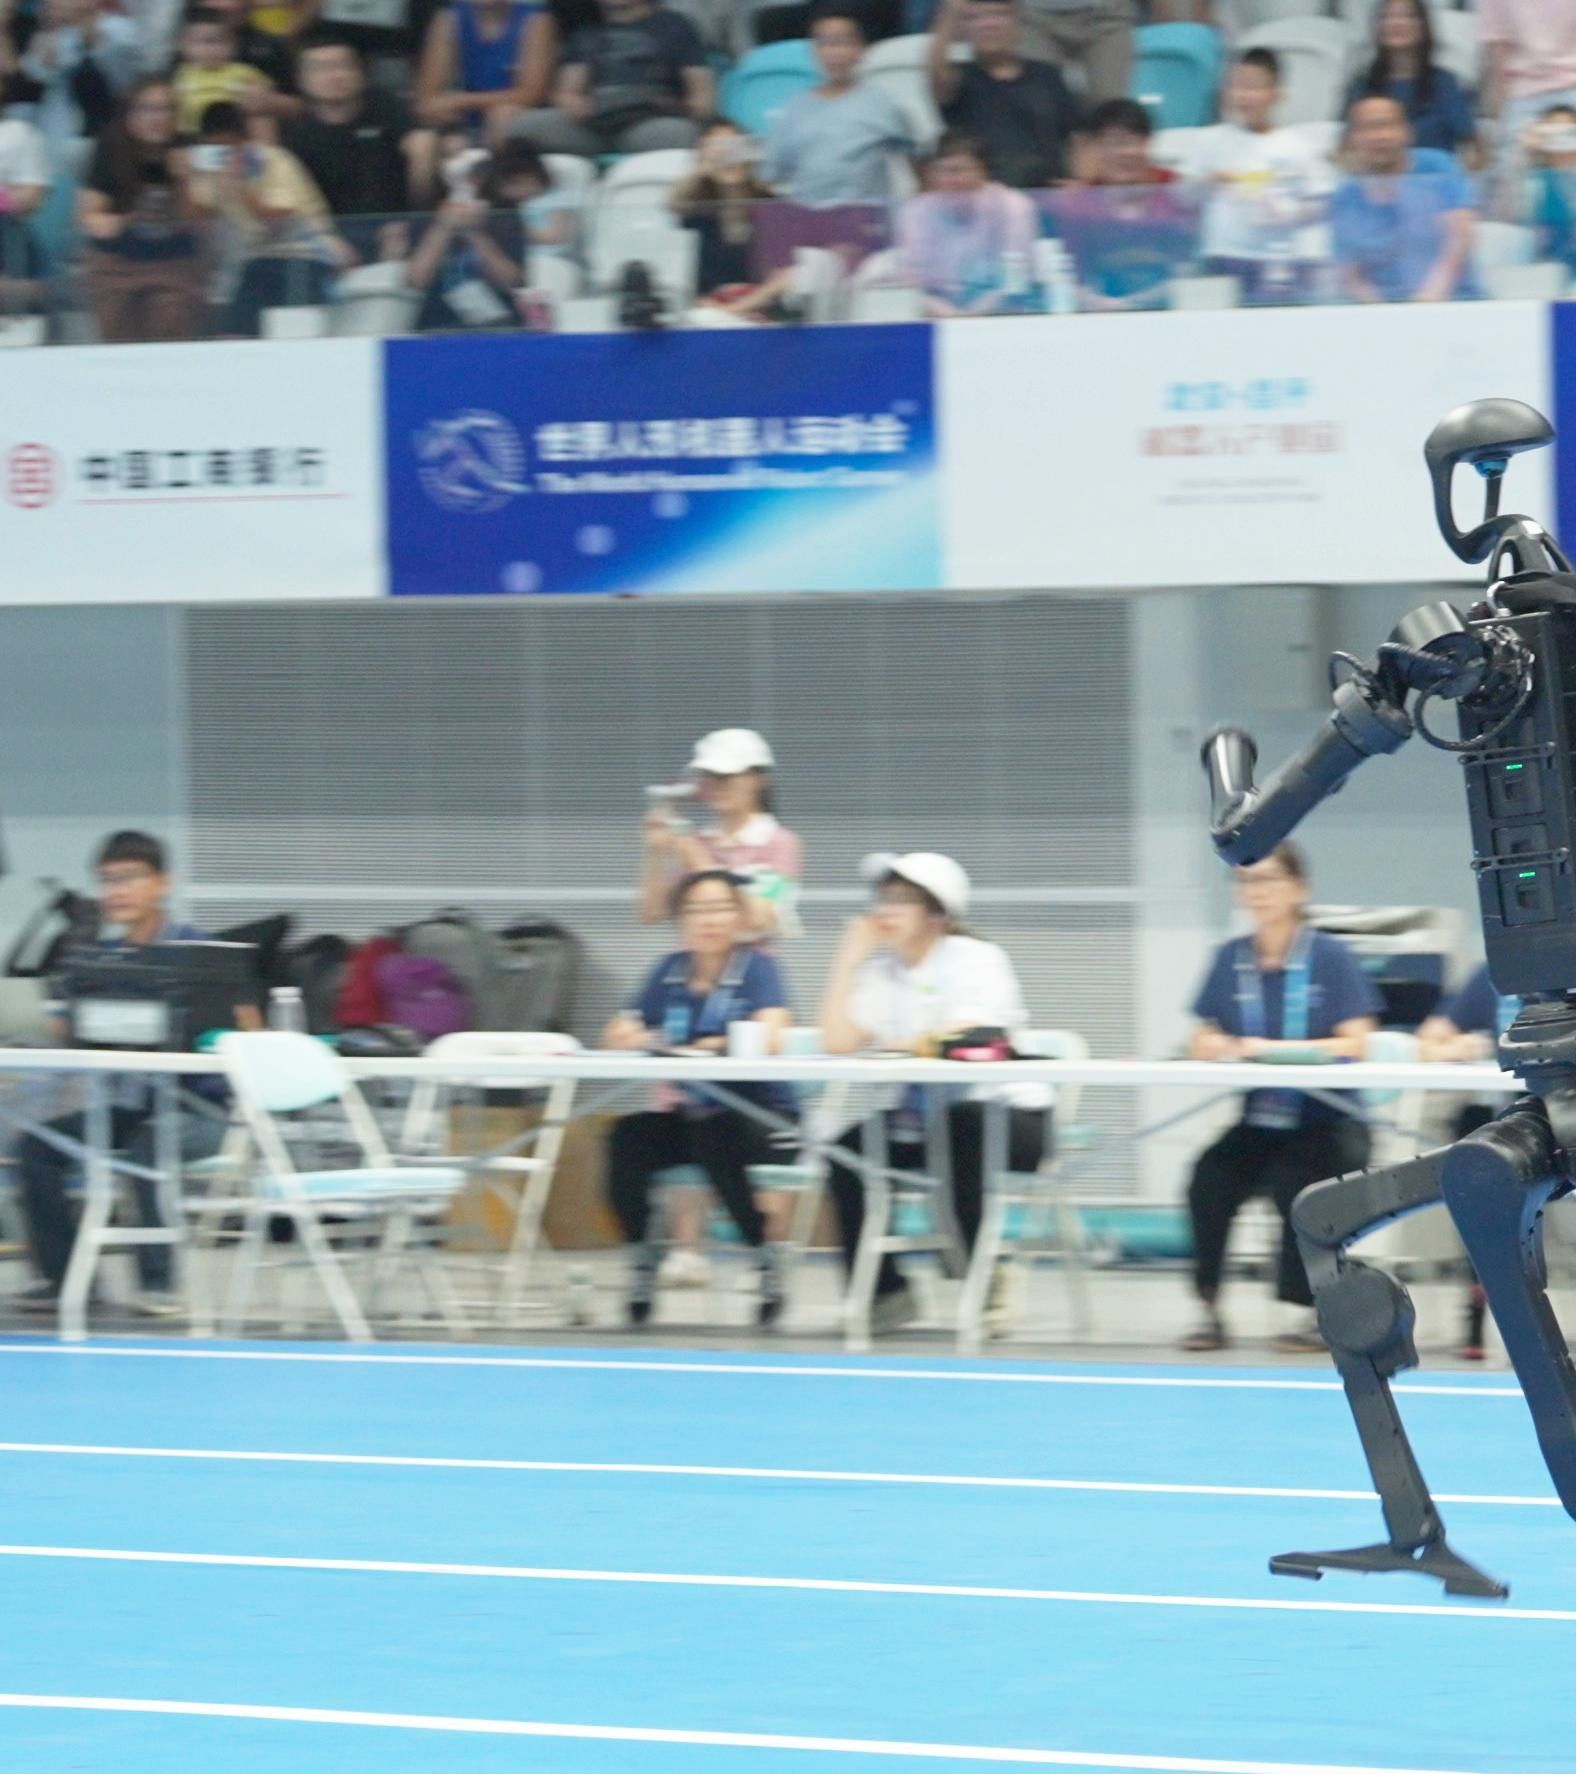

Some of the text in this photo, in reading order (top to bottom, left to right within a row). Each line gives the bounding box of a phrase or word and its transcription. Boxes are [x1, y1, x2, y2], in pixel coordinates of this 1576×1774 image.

[82, 447, 326, 491] 中国工商银行
